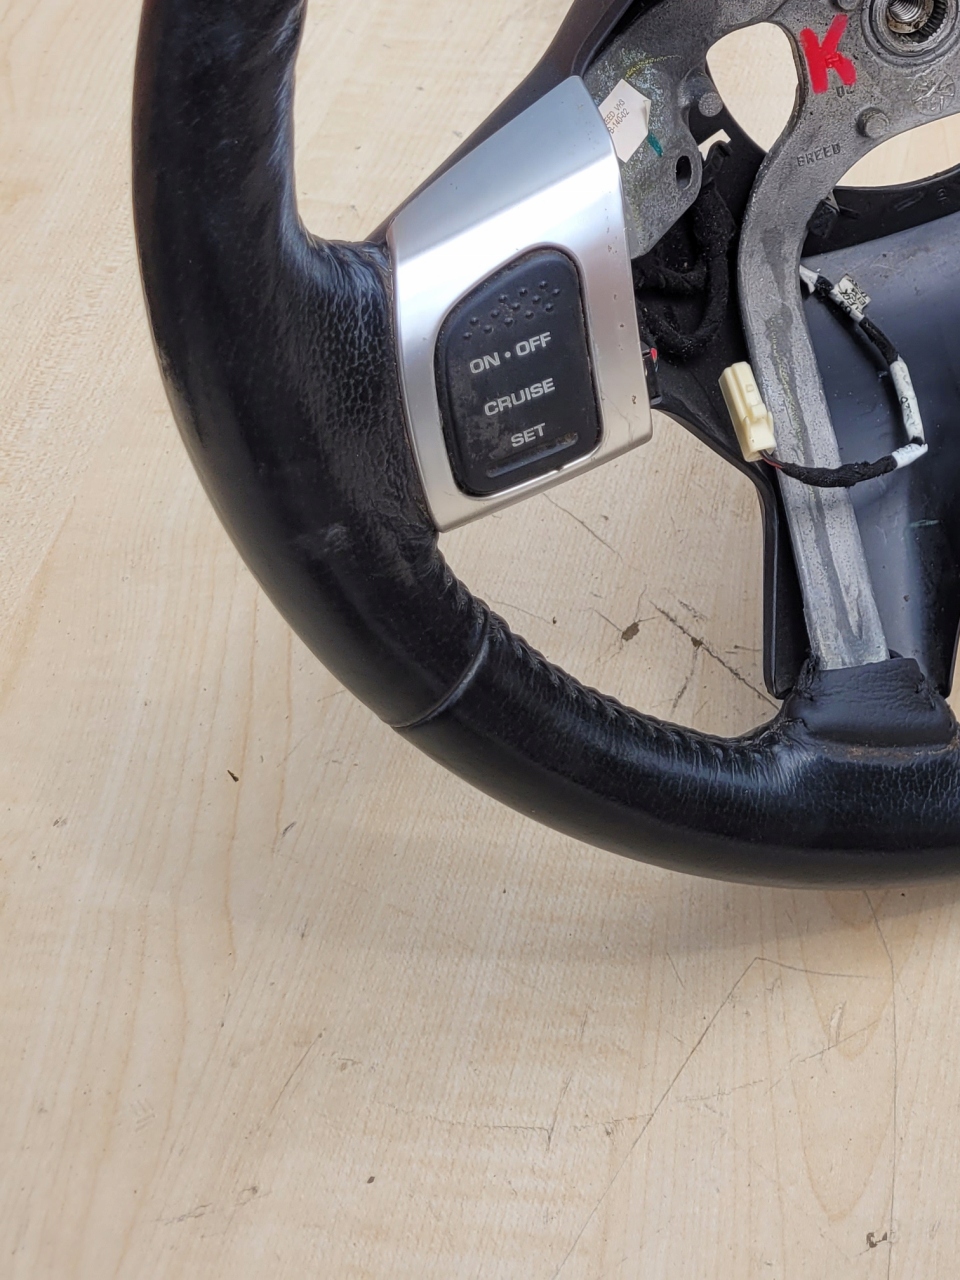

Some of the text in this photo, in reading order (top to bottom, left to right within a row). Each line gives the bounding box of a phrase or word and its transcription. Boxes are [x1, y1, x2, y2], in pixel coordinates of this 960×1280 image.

[800, 13, 857, 95] K
[797, 143, 841, 167] BREED
[469, 331, 552, 374] ON OFF
[484, 378, 556, 416] CRUISE
[511, 423, 546, 448] SET
